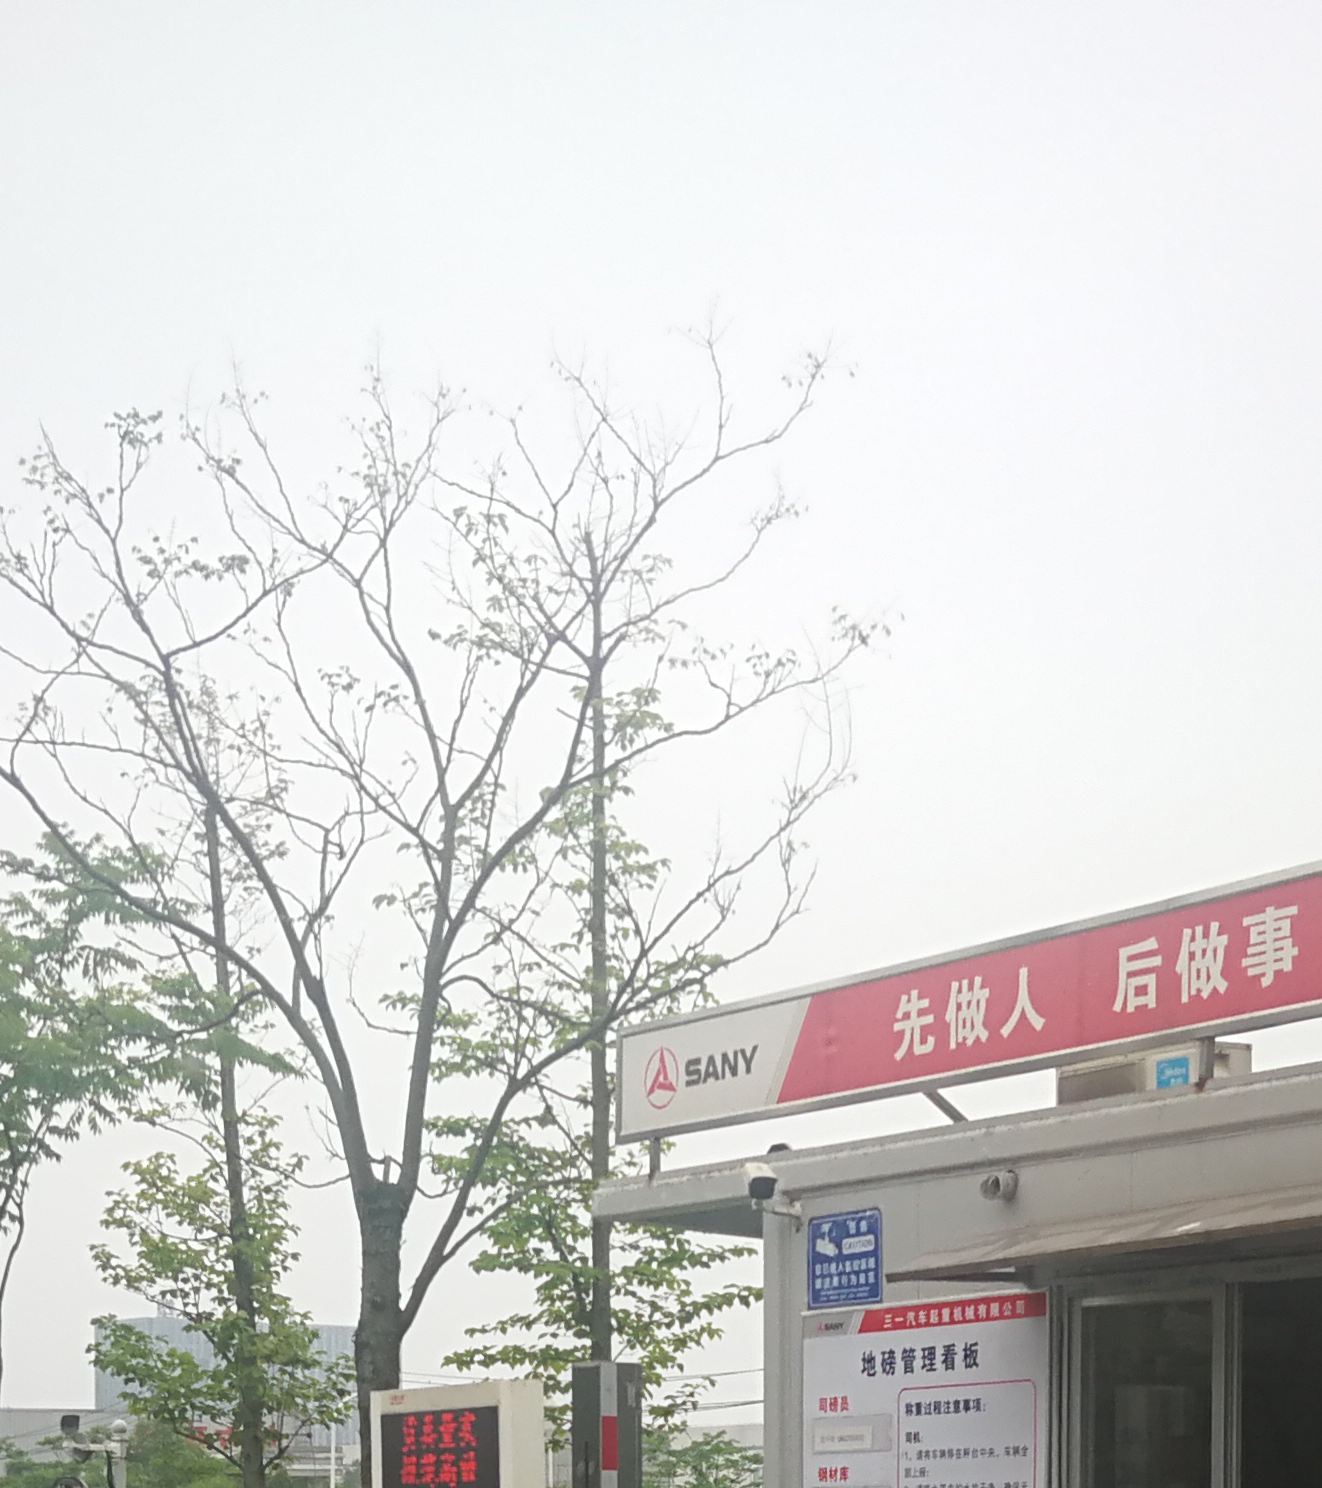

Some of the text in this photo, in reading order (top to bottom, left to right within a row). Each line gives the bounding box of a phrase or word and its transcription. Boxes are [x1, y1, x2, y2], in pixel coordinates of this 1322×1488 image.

[892, 965, 1047, 1062] 先做人
[1112, 903, 1301, 1014] 后做事
[684, 1045, 759, 1087] SANY
[882, 1299, 1026, 1329] 三一汽车起重机械有限公司
[860, 1341, 980, 1378] 地磅管理看板
[818, 1396, 850, 1413] 司磅员
[817, 1466, 850, 1483] 钢材库
